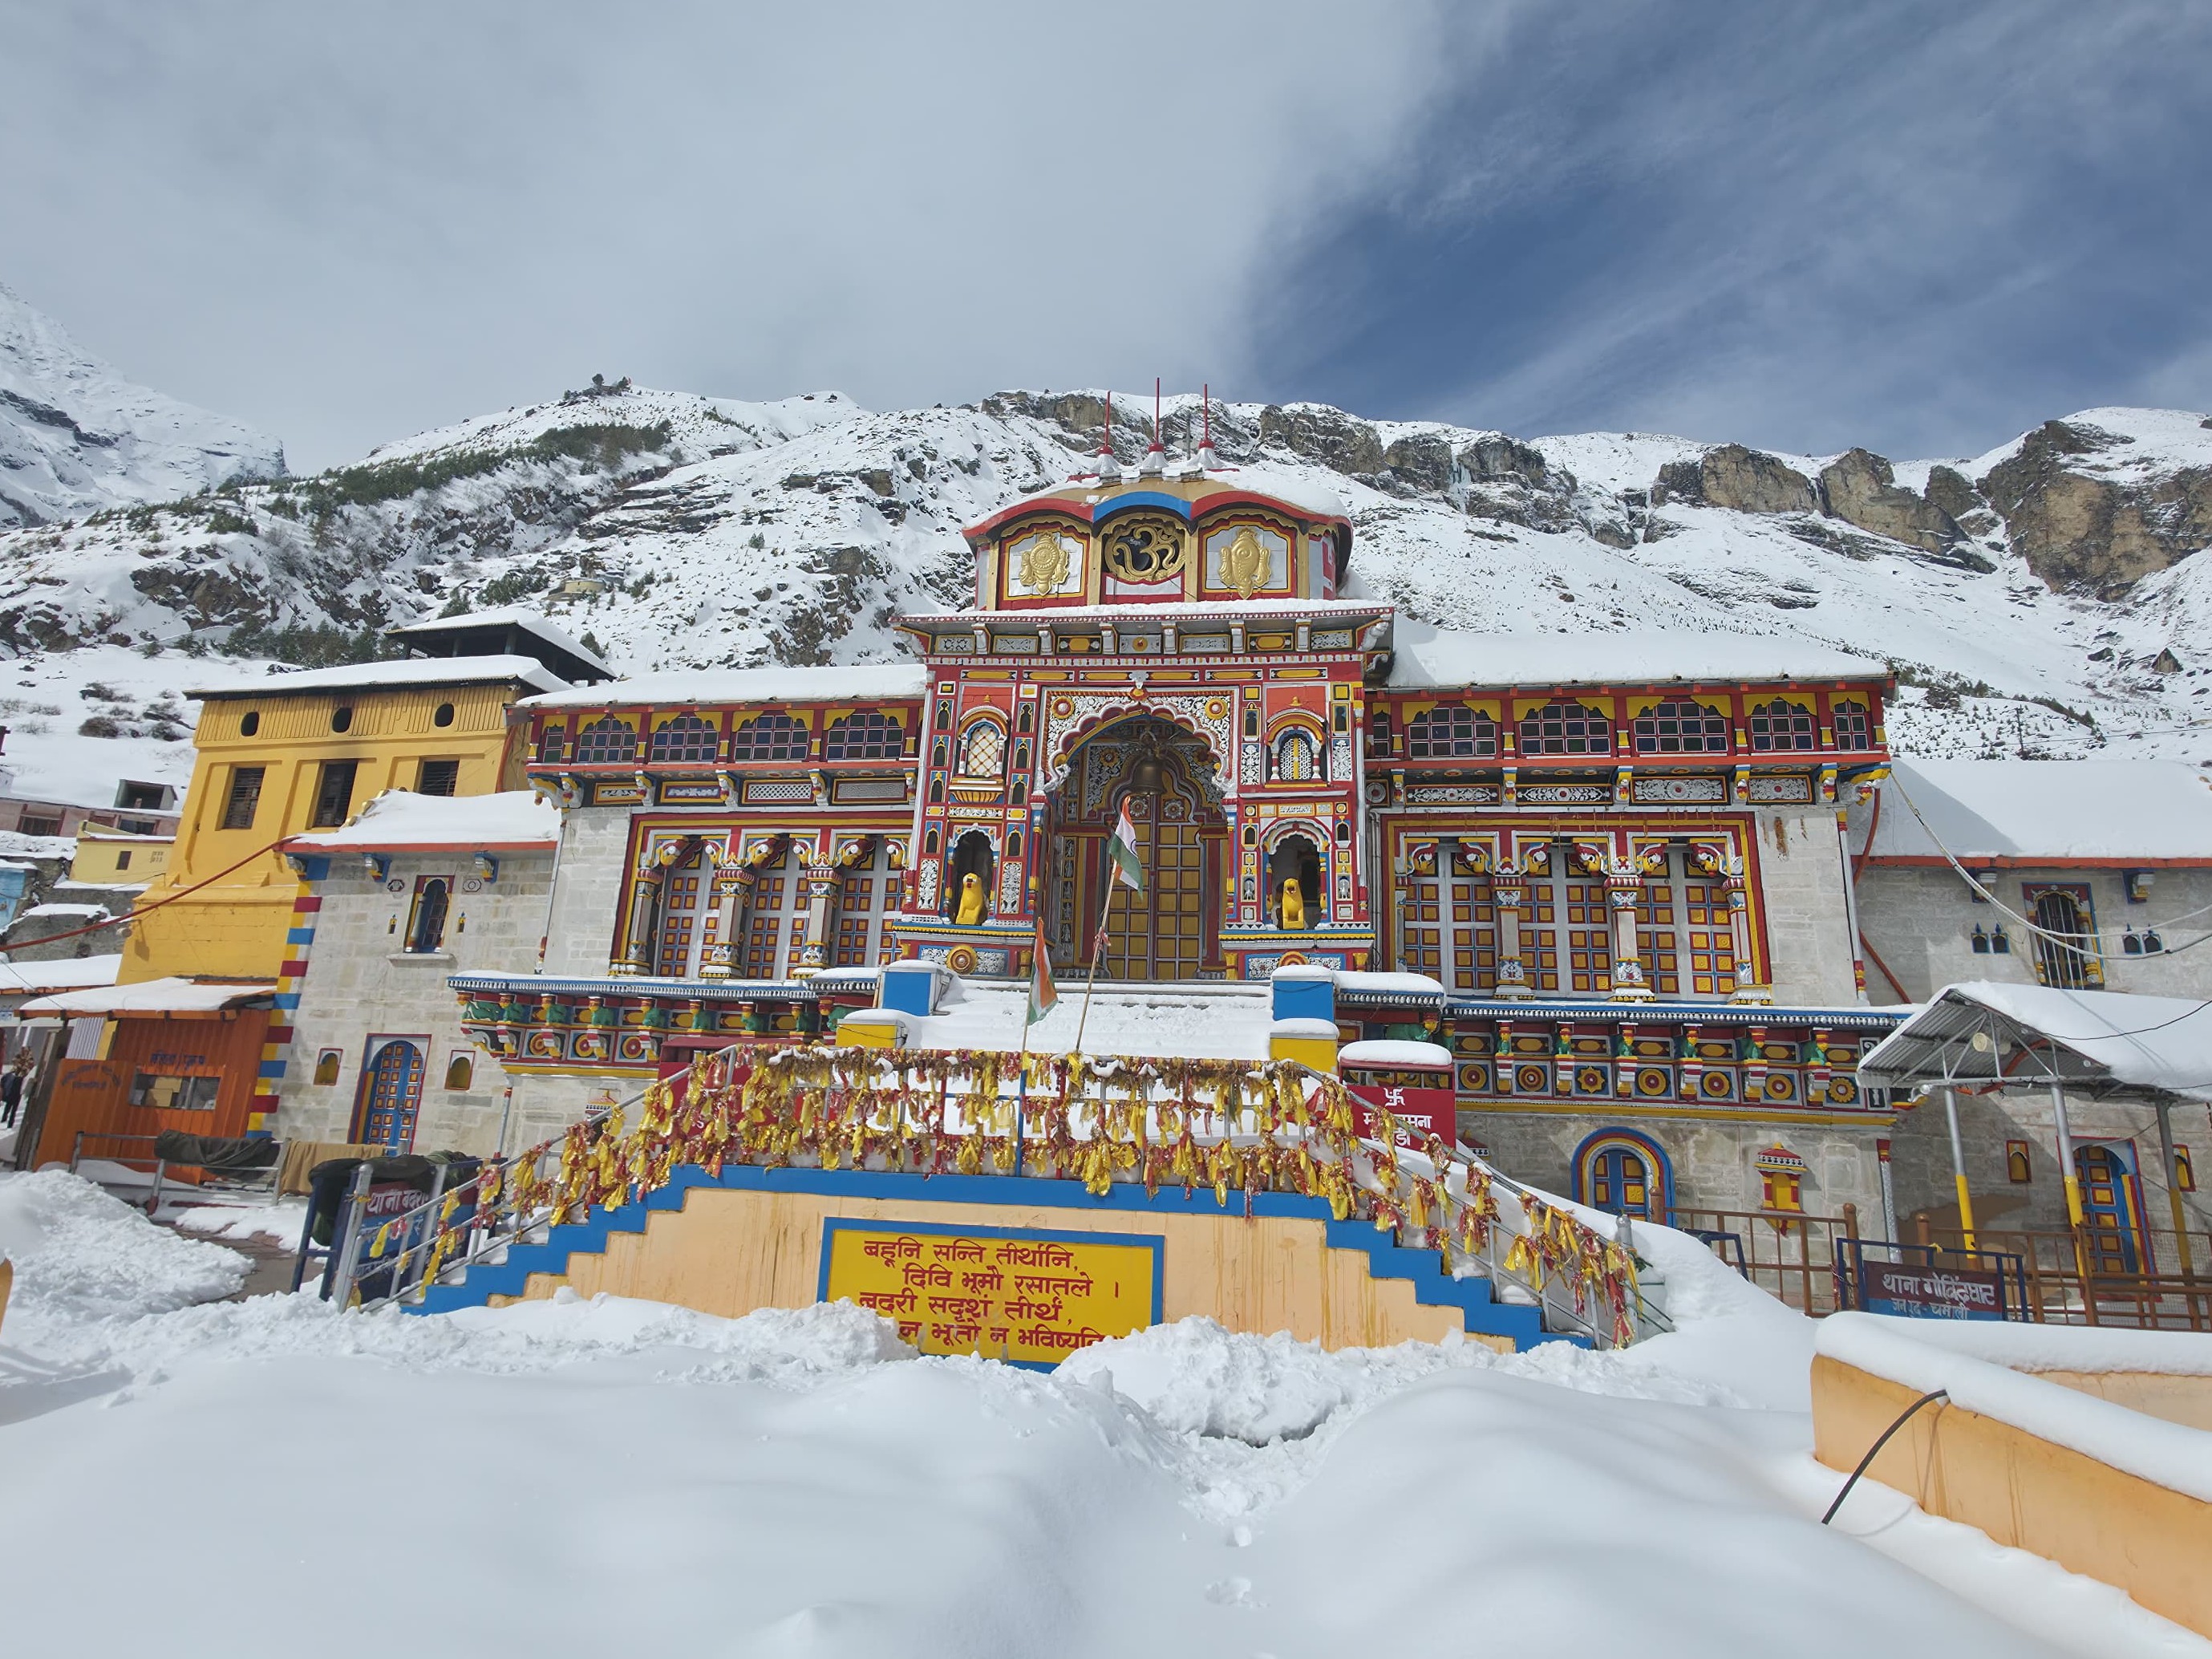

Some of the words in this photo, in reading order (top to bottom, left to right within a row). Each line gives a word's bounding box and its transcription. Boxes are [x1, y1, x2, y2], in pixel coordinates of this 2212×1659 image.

[863, 1236, 924, 1268] बहूनि
[932, 1239, 986, 1264] सन्ति
[995, 1242, 1078, 1272] तीर्थानि,
[901, 1262, 954, 1290] दिवि
[1014, 1271, 1094, 1297] रसातले
[1882, 1273, 1921, 1296] थाना
[859, 1287, 918, 1314] बदरी
[898, 1320, 923, 1338] न
[931, 1317, 982, 1347] भूतो
[990, 1326, 1010, 1345] न
